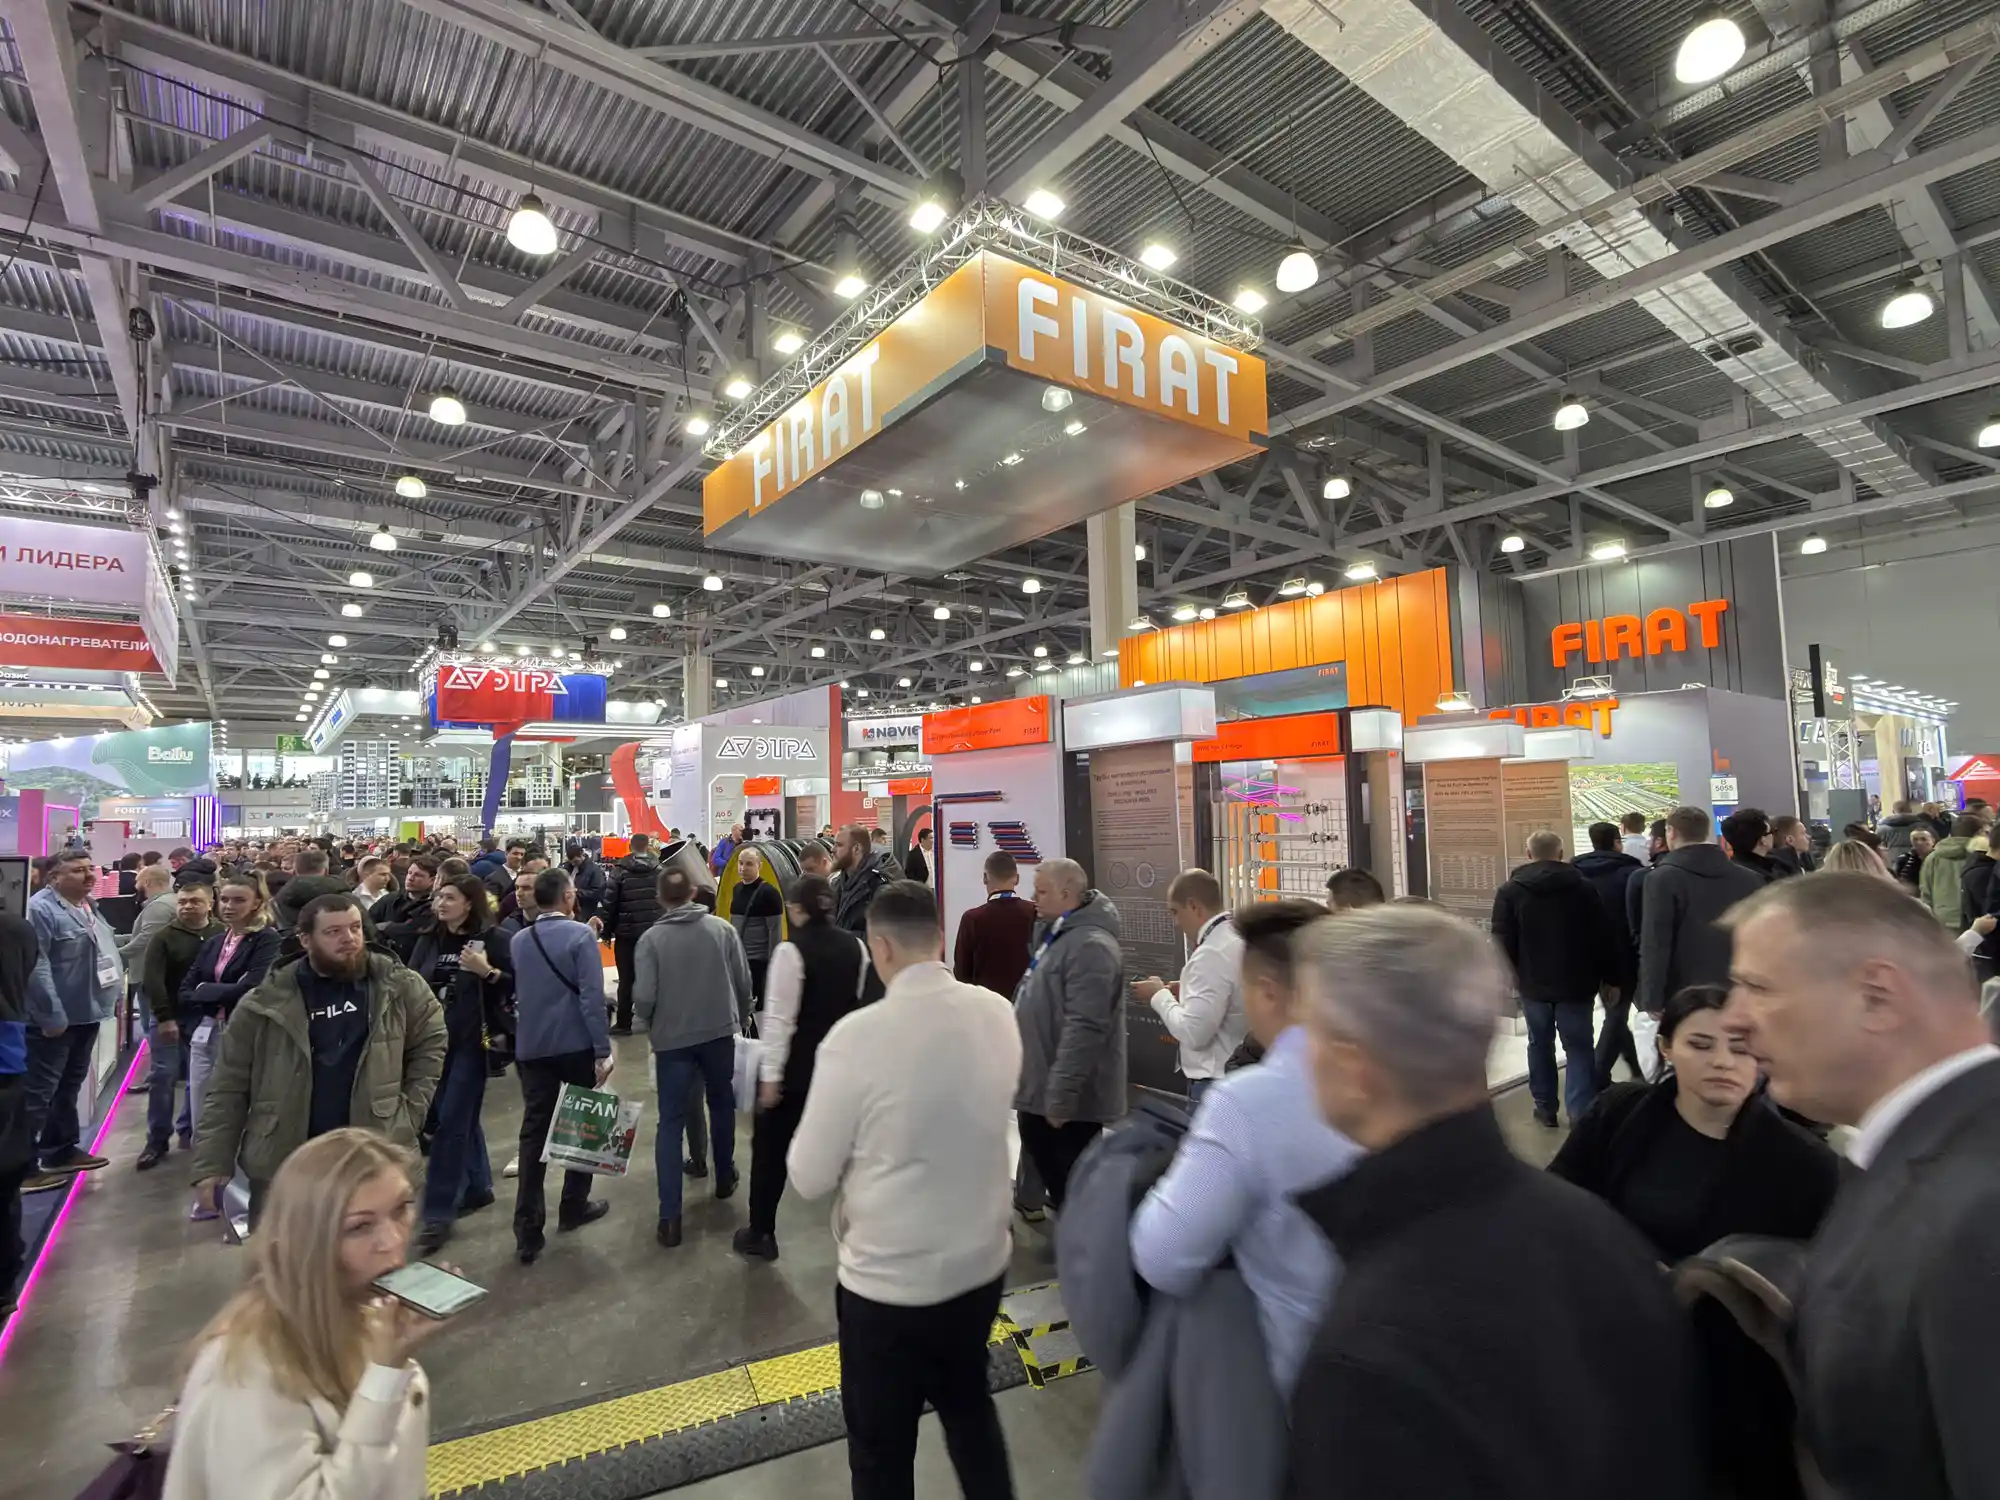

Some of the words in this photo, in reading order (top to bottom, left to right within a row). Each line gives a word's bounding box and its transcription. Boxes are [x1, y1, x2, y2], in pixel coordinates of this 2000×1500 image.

[1017, 278, 1239, 426] FIRAT
[752, 343, 880, 507] FIRAT
[16, 547, 125, 573] ЛИДЕРА
[1552, 599, 1729, 668] FIRAT
[494, 669, 569, 695] ЭТРА
[147, 746, 194, 761] Ballu
[755, 738, 817, 760] ЭТРА
[115, 806, 148, 815] FORTE
